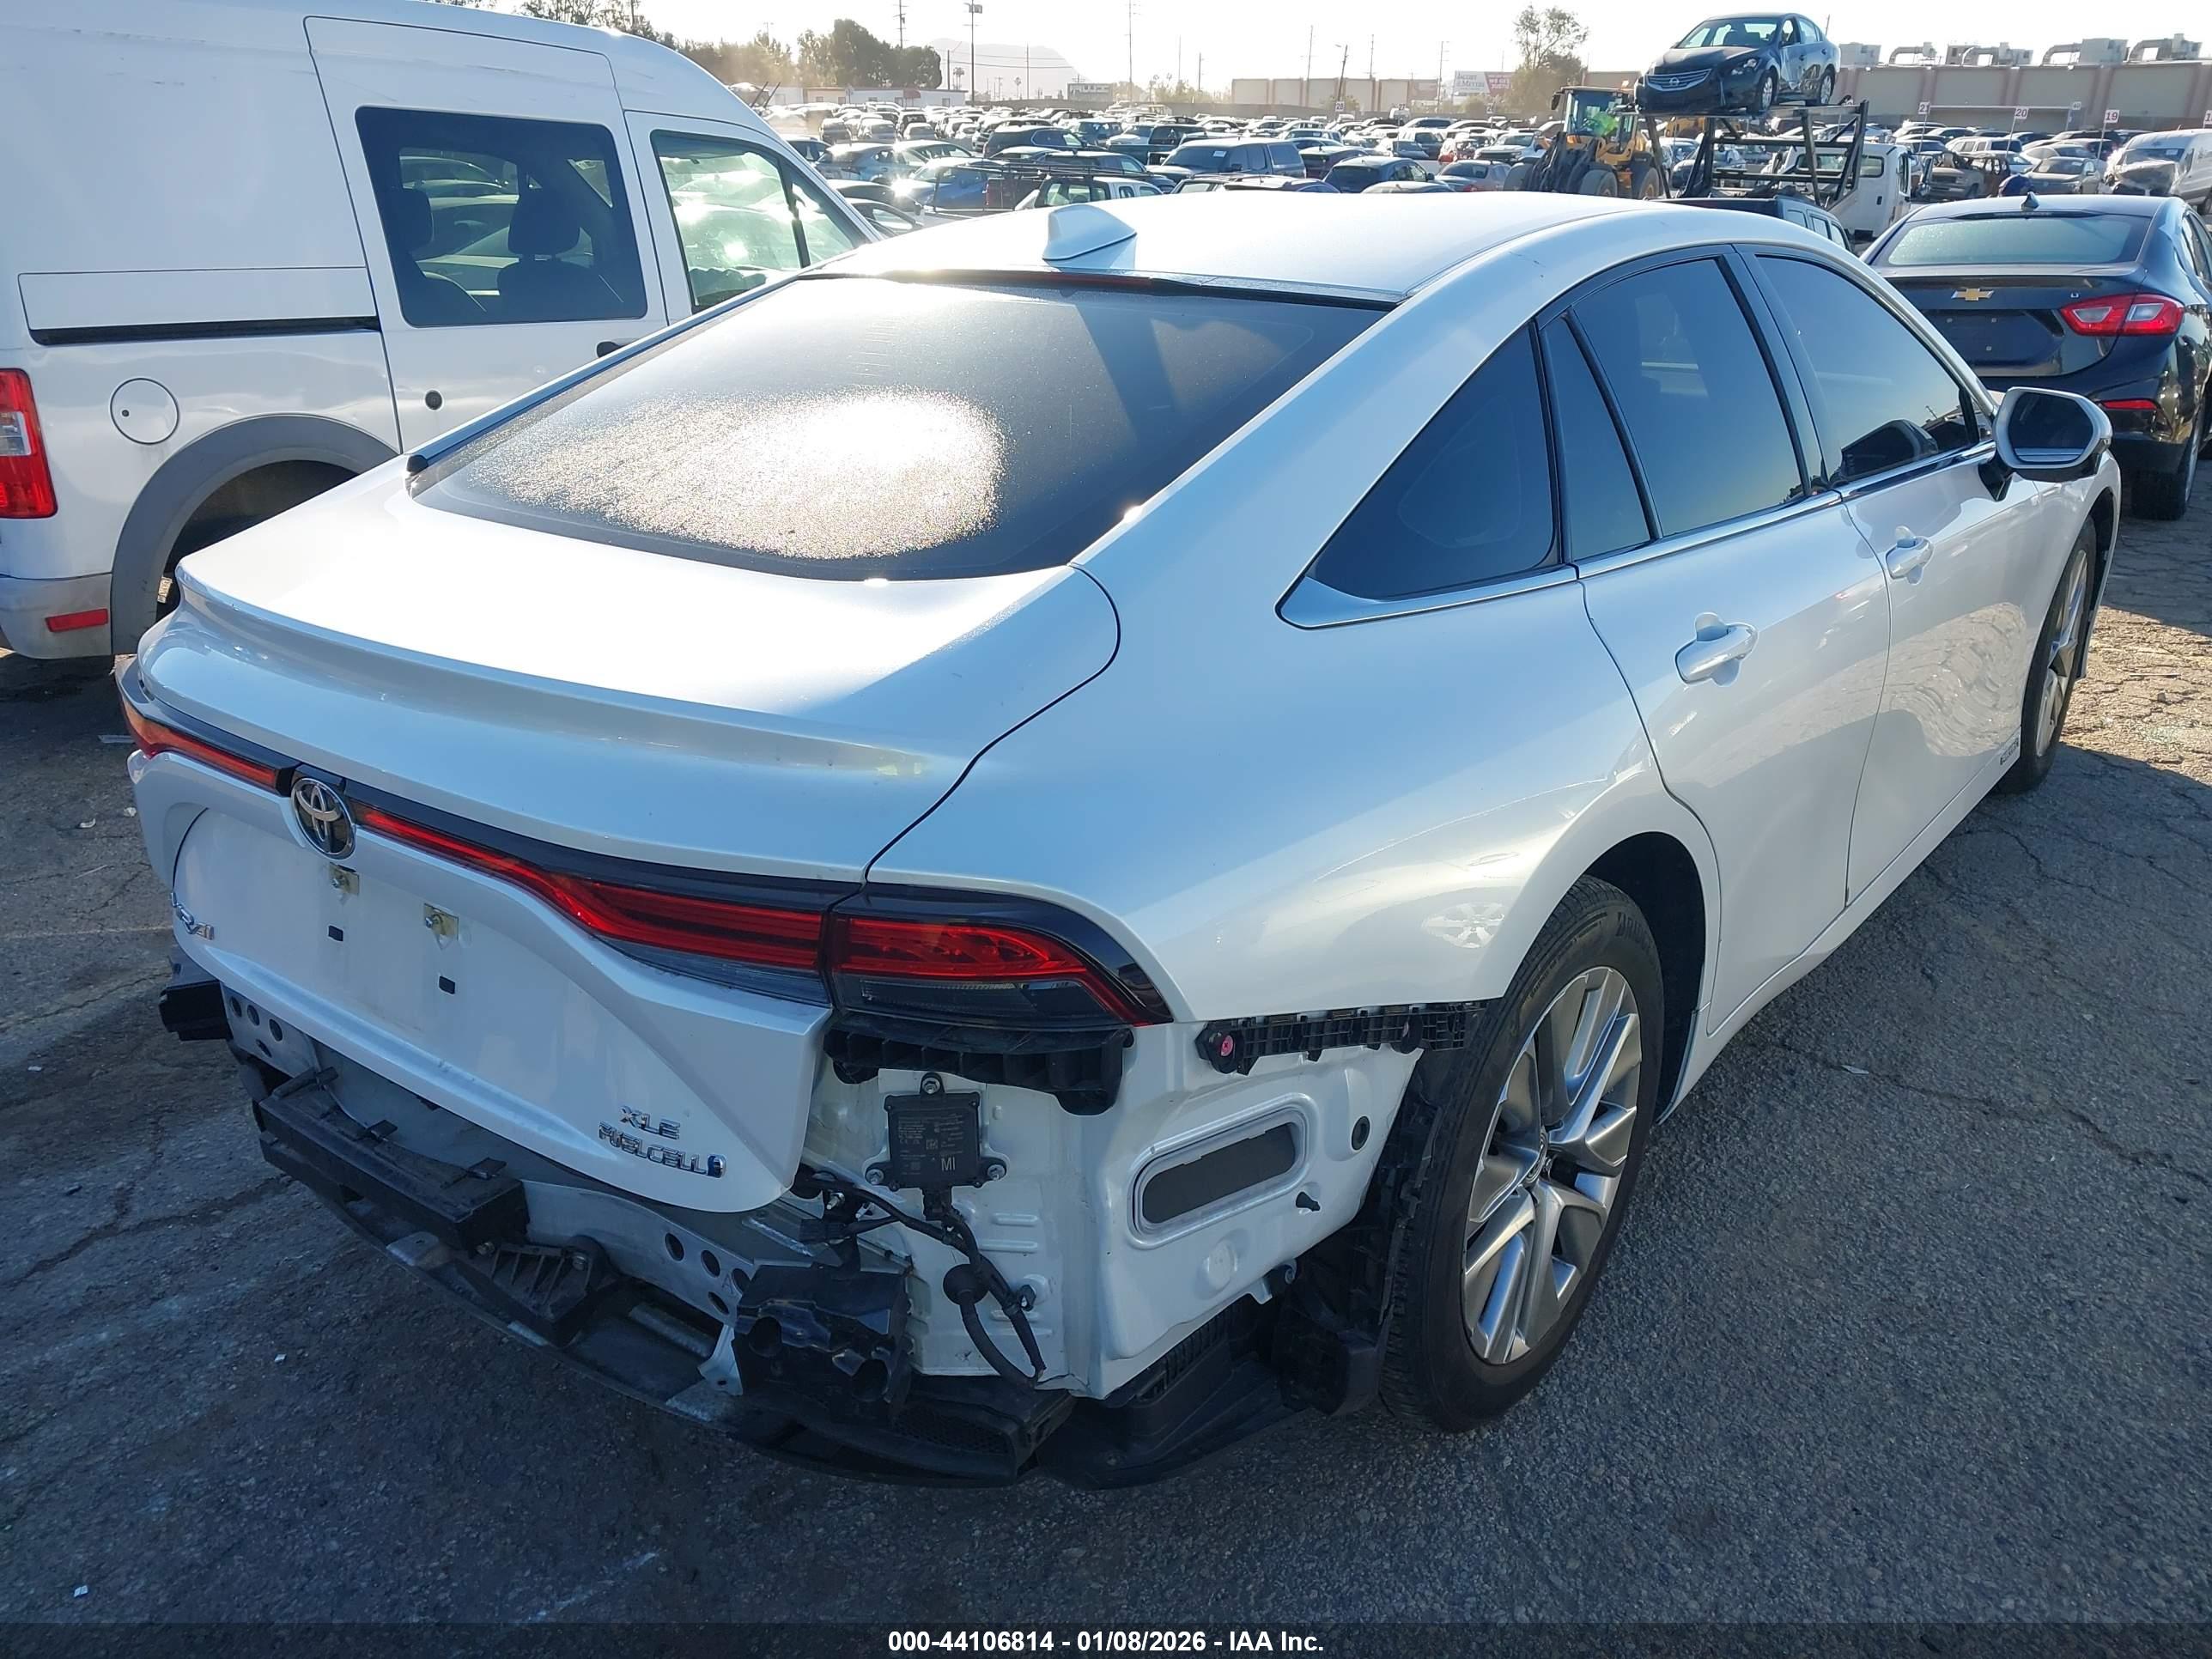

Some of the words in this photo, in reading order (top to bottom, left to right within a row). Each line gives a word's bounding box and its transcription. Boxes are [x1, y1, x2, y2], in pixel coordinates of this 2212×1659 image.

[2014, 108, 2027, 118] 20
[2106, 111, 2118, 121] 19
[619, 1105, 681, 1140] XLE
